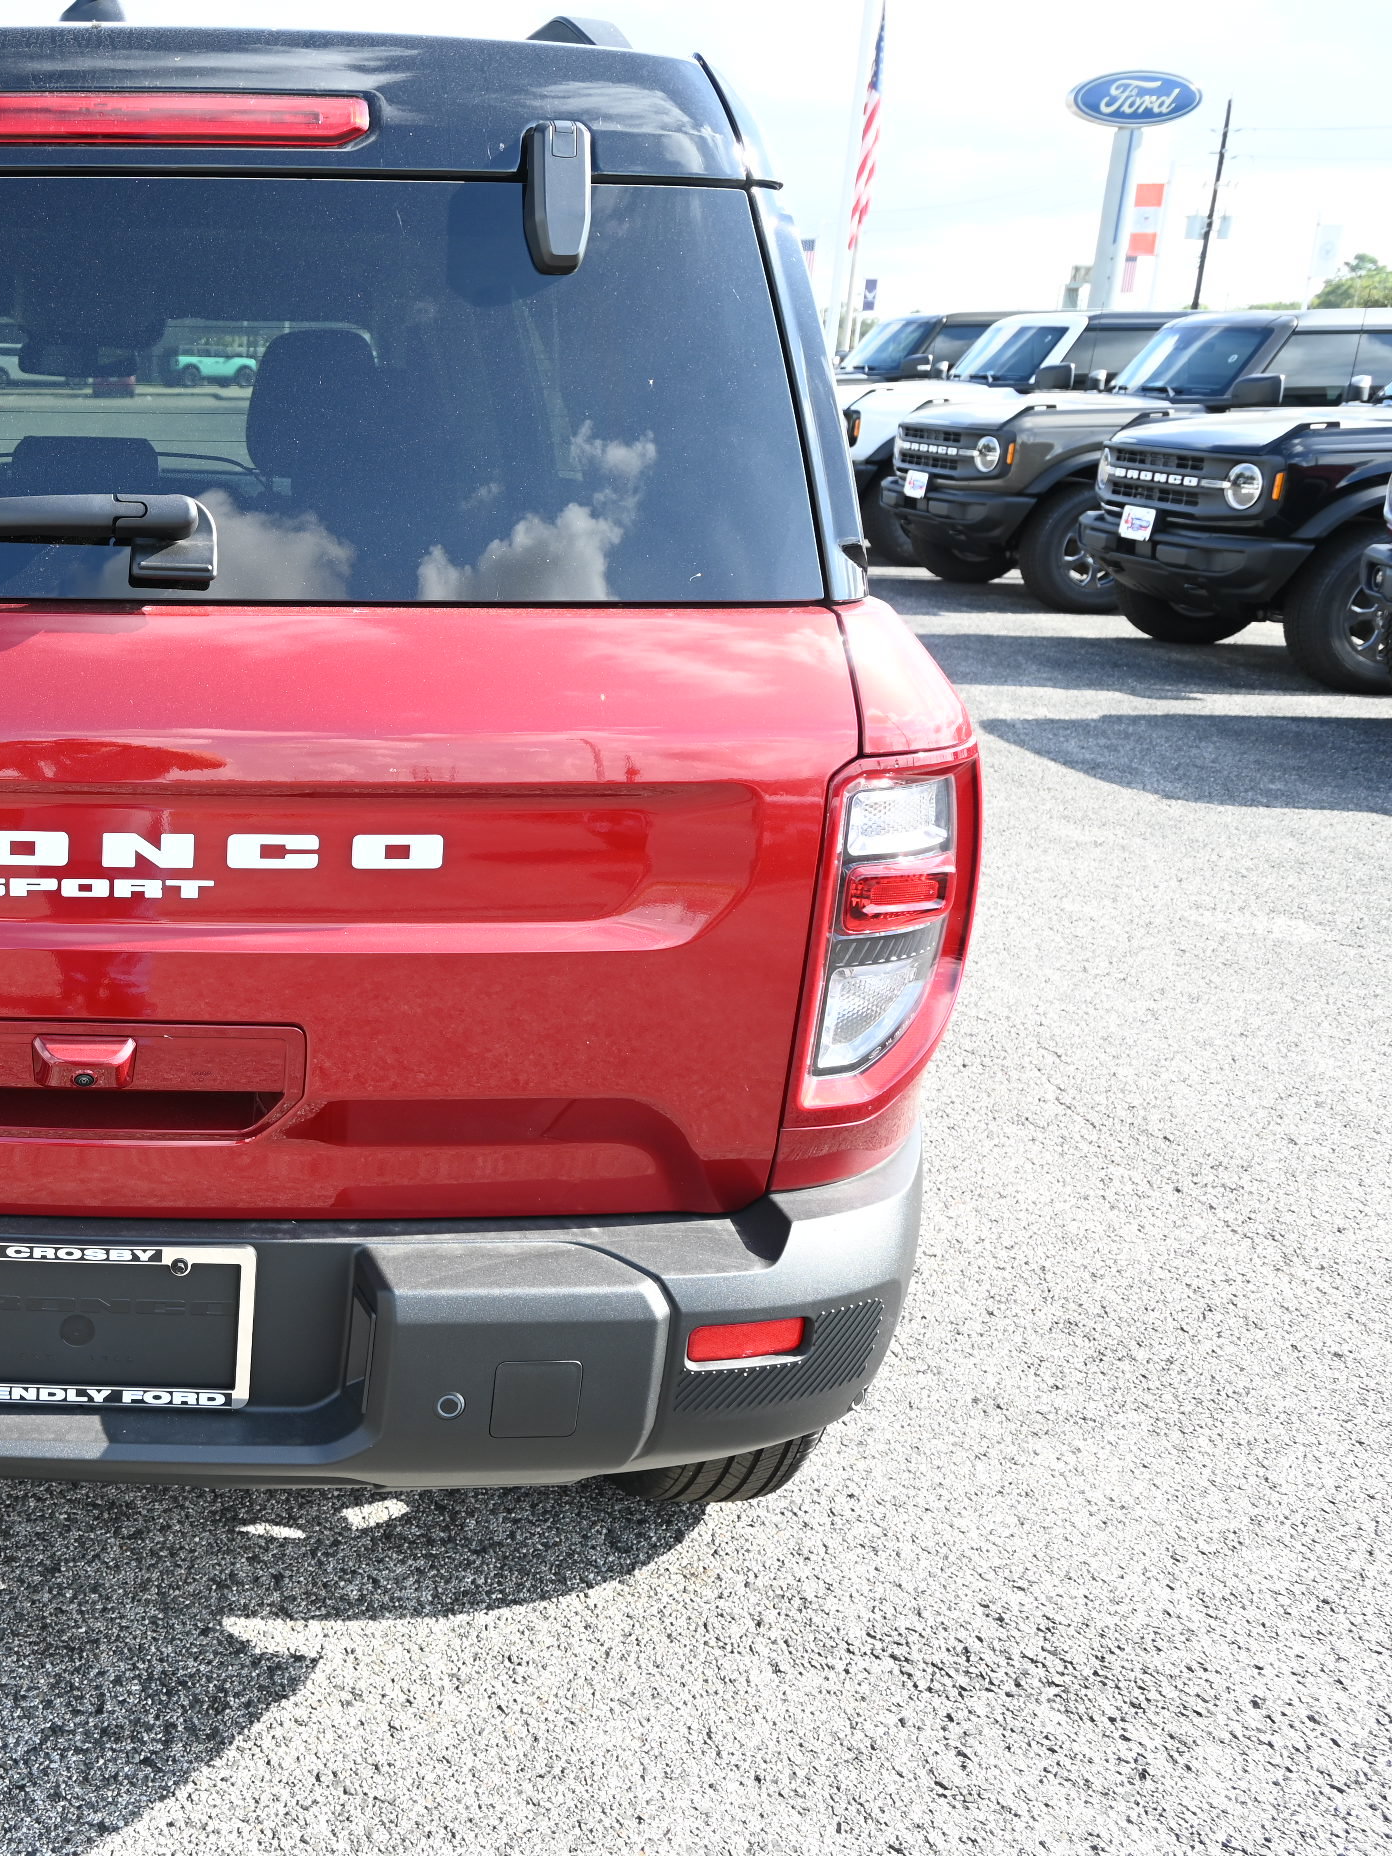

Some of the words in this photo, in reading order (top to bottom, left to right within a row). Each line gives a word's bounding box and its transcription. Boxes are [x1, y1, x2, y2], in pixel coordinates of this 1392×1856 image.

[1099, 79, 1181, 114] Ford
[1114, 467, 1199, 487] BRONCO
[5, 1246, 157, 1262] CROSBY
[121, 1390, 226, 1407] FORD
